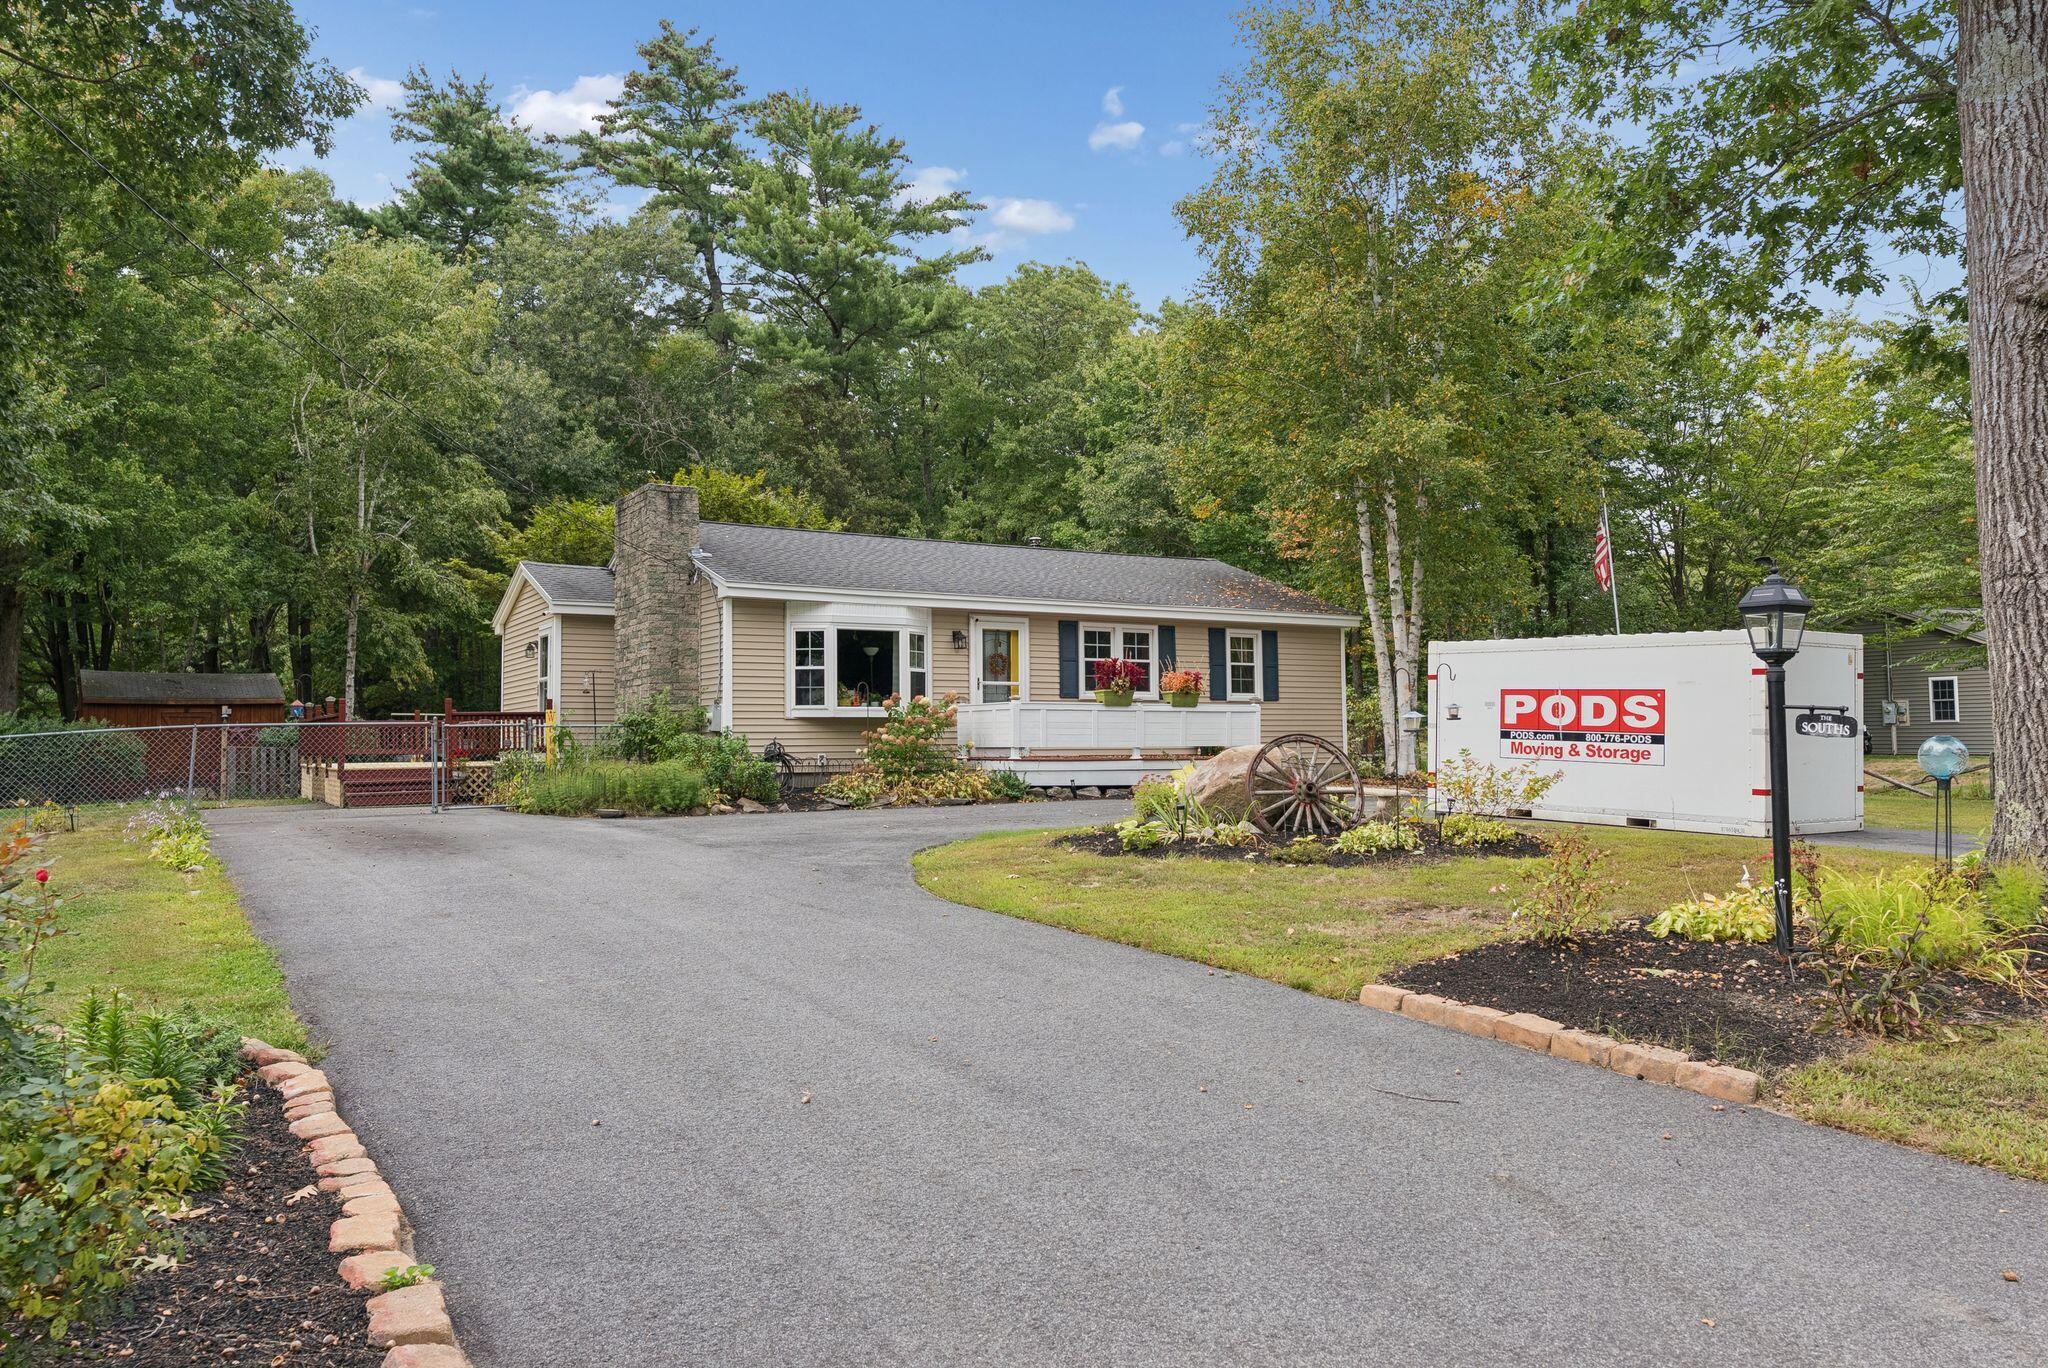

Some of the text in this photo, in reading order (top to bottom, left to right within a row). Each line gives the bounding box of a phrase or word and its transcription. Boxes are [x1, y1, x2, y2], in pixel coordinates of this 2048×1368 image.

[1504, 695, 1660, 728] PODS
[1510, 731, 1554, 740] PODS.com
[1801, 722, 1850, 736] SOUTHS
[1585, 734, 1652, 743] 800-776-PODS
[1510, 741, 1651, 762] Moving & Storage
